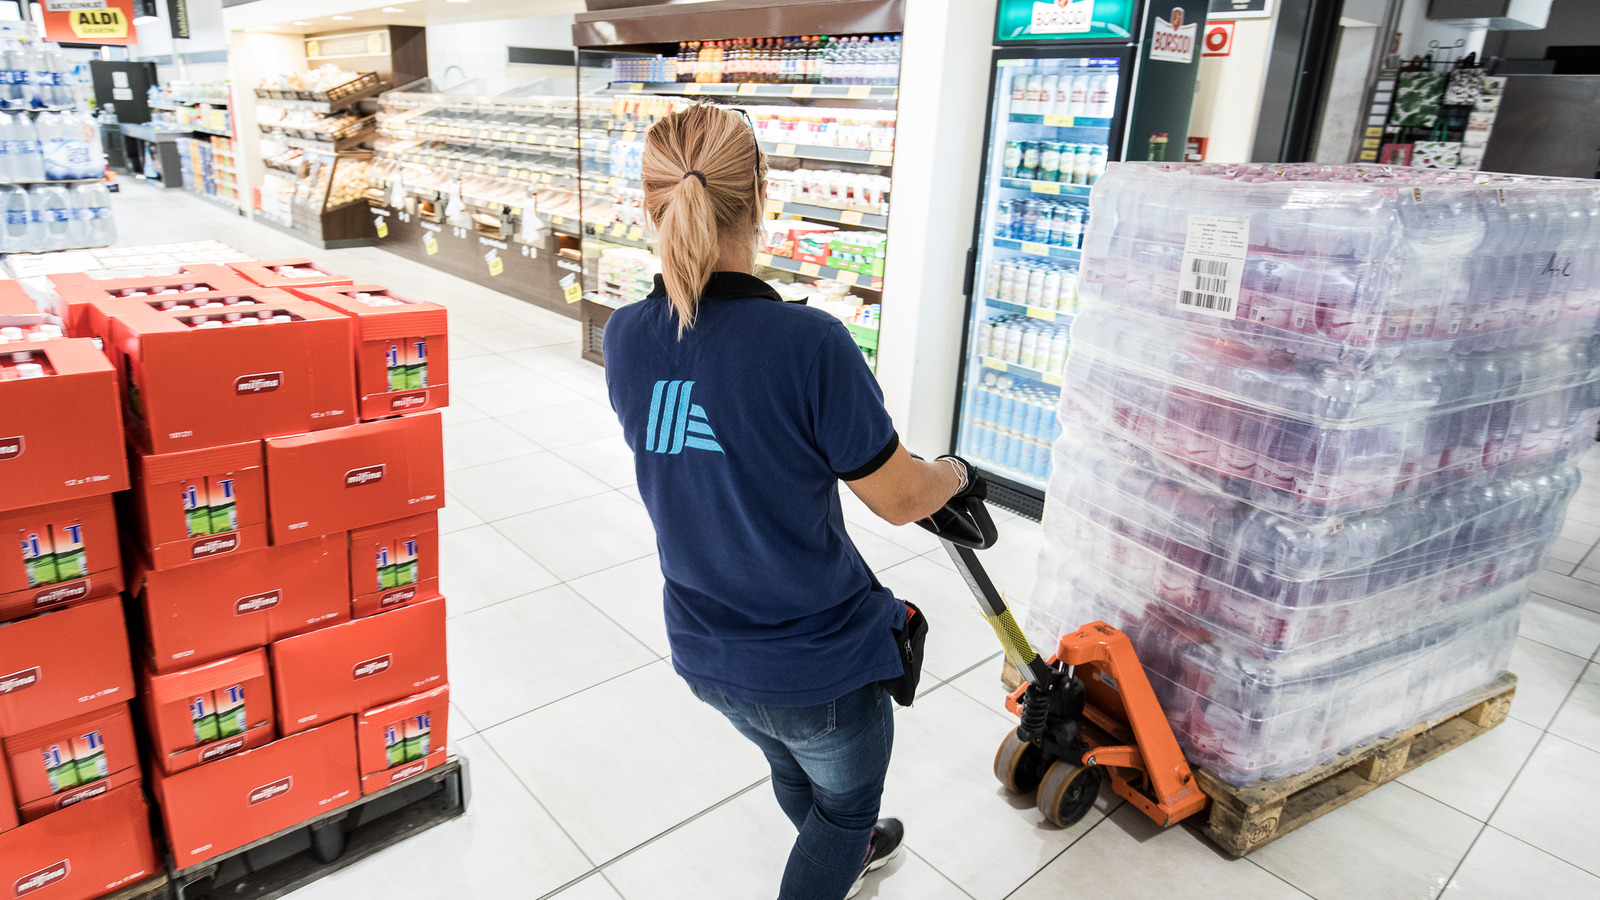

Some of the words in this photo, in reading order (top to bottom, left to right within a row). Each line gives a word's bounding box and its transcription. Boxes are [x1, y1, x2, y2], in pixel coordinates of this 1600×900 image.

[79, 12, 119, 25] ALDI
[1036, 10, 1087, 27] BORSODI
[1154, 31, 1191, 54] BORSODI
[237, 378, 279, 391] milfina
[392, 396, 425, 407] milfina
[347, 471, 382, 483] milfina
[193, 540, 235, 554] milfina
[37, 586, 85, 604] milfina
[382, 591, 414, 605] milfina
[238, 596, 278, 611] milfina
[355, 660, 389, 675] milfina
[392, 764, 424, 781] milfina
[61, 786, 106, 807] milfina
[251, 783, 289, 802] milfina
[18, 867, 65, 893] milfina
